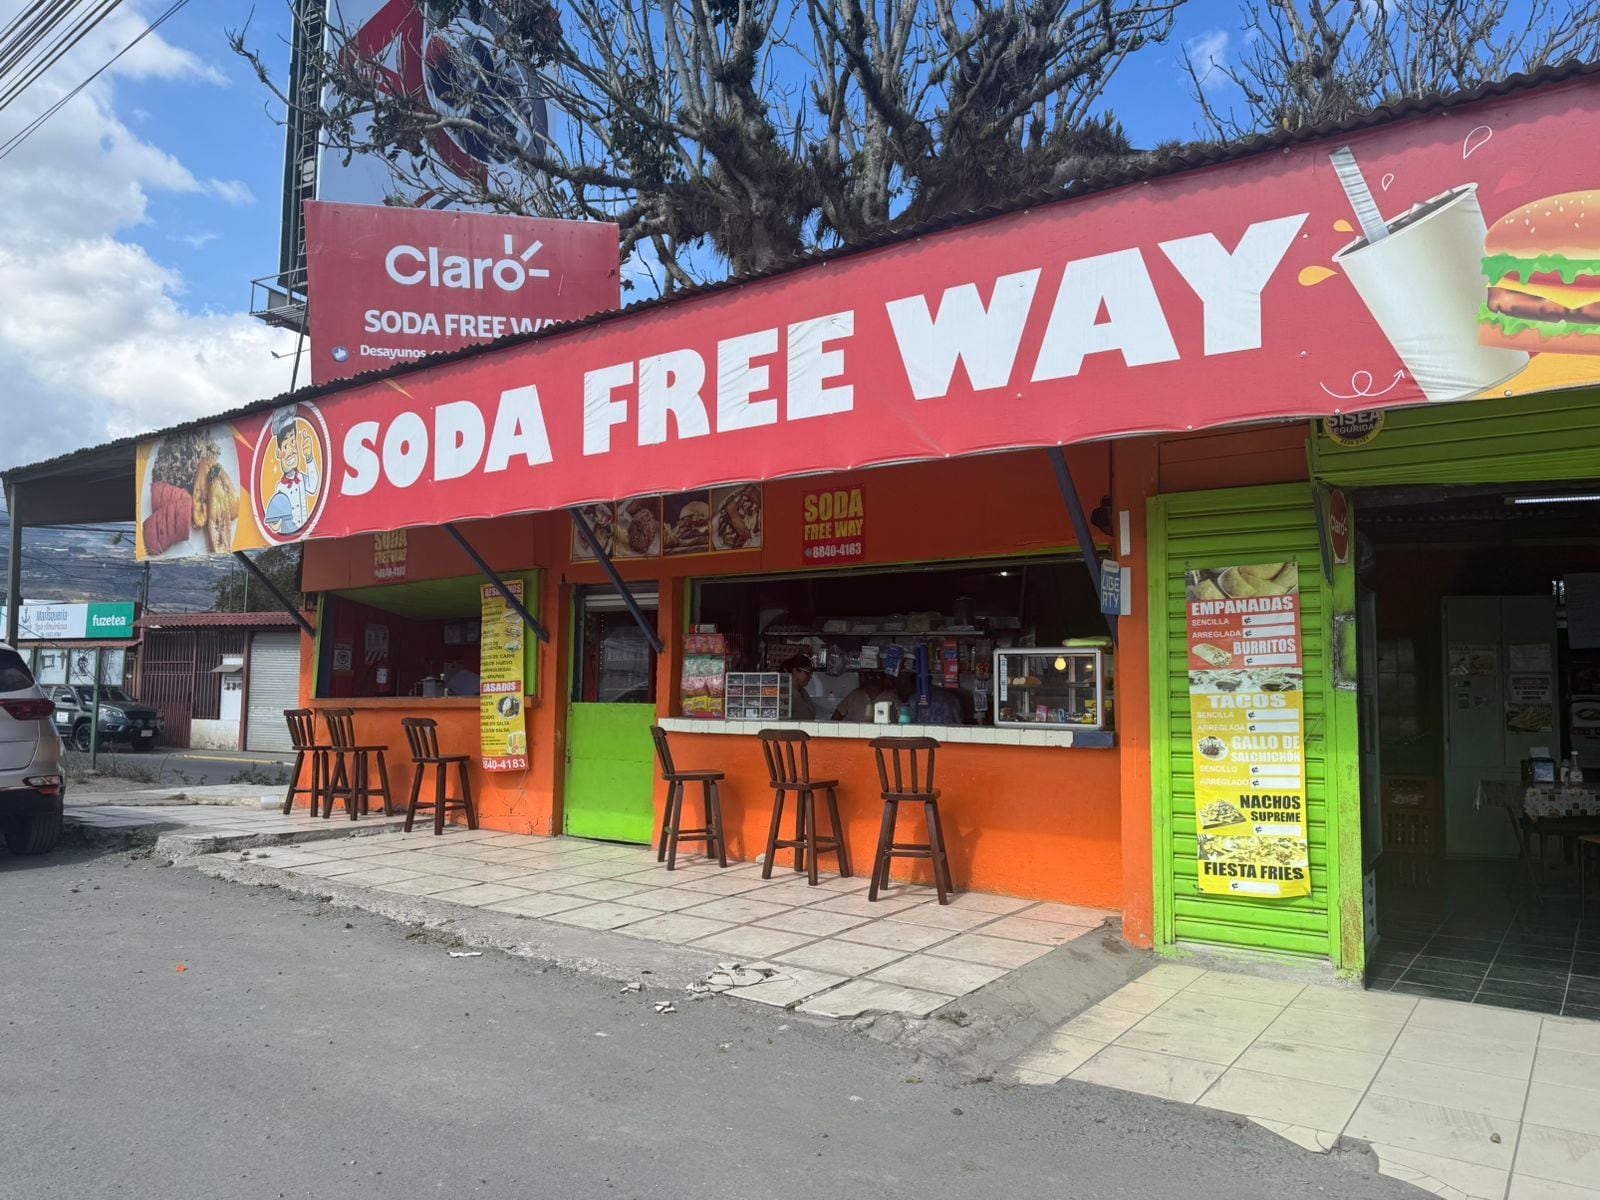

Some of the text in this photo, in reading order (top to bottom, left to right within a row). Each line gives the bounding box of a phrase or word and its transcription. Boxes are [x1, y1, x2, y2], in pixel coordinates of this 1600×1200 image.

[385, 244, 526, 291] Claro
[364, 309, 440, 335] SODA
[445, 314, 507, 338] FREE
[341, 212, 1310, 496] SODA FREE WAY
[804, 488, 864, 523] SODA
[804, 519, 864, 541] FREE WAY
[1331, 515, 1346, 536] Claro
[374, 529, 408, 550] SODA
[812, 542, 862, 559] 8840-4183
[1192, 596, 1294, 616] EMPANADAS
[93, 614, 126, 627] fuzetea
[1192, 618, 1230, 626] SENCILLA
[1192, 630, 1242, 639] ARREGLADA
[1233, 638, 1296, 655] BURRITOS
[1207, 693, 1287, 709] TACOS
[1198, 724, 1246, 732] ARREGLADA
[1231, 735, 1300, 750] GALLO DE
[1200, 765, 1238, 773] SENCILLO
[1200, 778, 1249, 786] ARREGLADO
[1240, 795, 1301, 809] NACHOS
[1250, 811, 1301, 822] SUPREME
[1204, 862, 1305, 880] FIESTA FRIES
